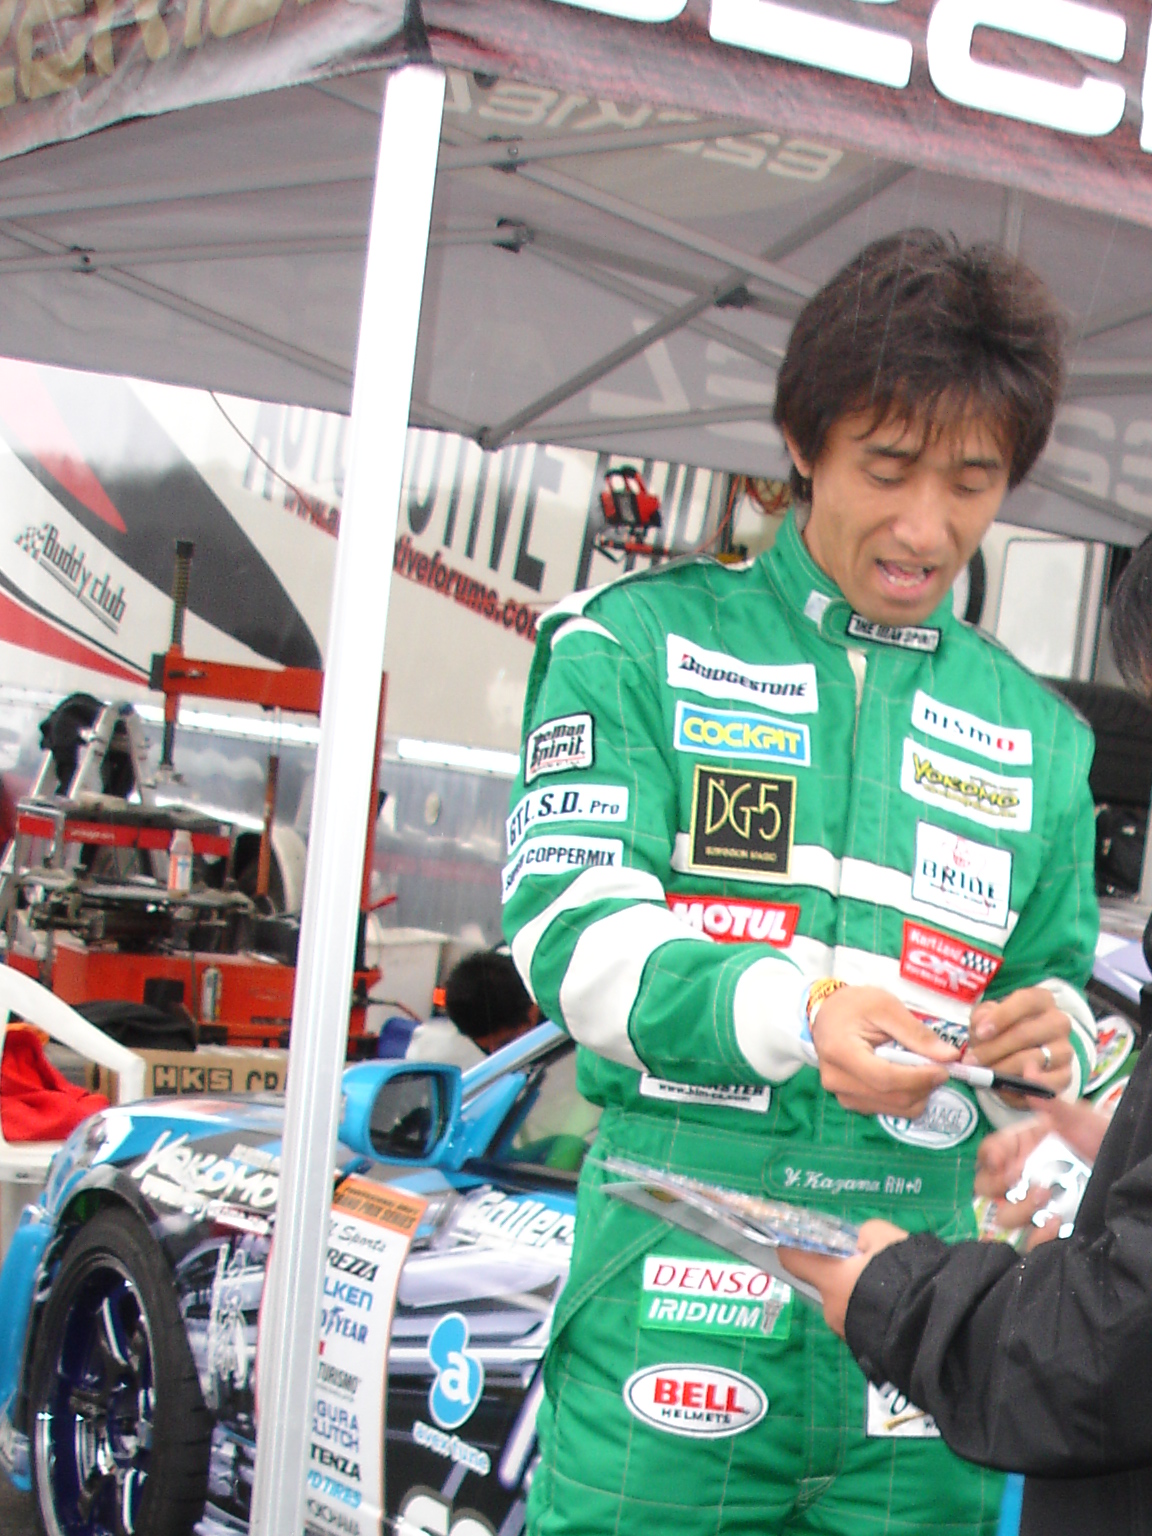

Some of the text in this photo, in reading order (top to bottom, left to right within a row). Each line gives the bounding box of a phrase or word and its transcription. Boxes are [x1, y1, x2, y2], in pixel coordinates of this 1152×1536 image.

[42, 522, 92, 600] Buddy
[679, 653, 807, 698] BRIDGESTONE
[683, 716, 802, 754] COCKPIT
[924, 707, 1015, 752] nismo
[589, 799, 621, 815] Pro
[525, 846, 616, 867] COPPERMIX
[922, 858, 1004, 899] BRIDE
[673, 902, 787, 940] MOTUL
[152, 1064, 234, 1096] HKS
[326, 1247, 380, 1283] REZZA
[652, 1263, 772, 1298] DENSO
[323, 1276, 374, 1313] LKEN
[649, 1297, 759, 1329] IRIDIUM
[653, 1376, 746, 1414] BELL
[317, 1399, 359, 1431] GURA
[660, 1407, 732, 1425] HELMETS
[310, 1442, 362, 1482] TENZA
